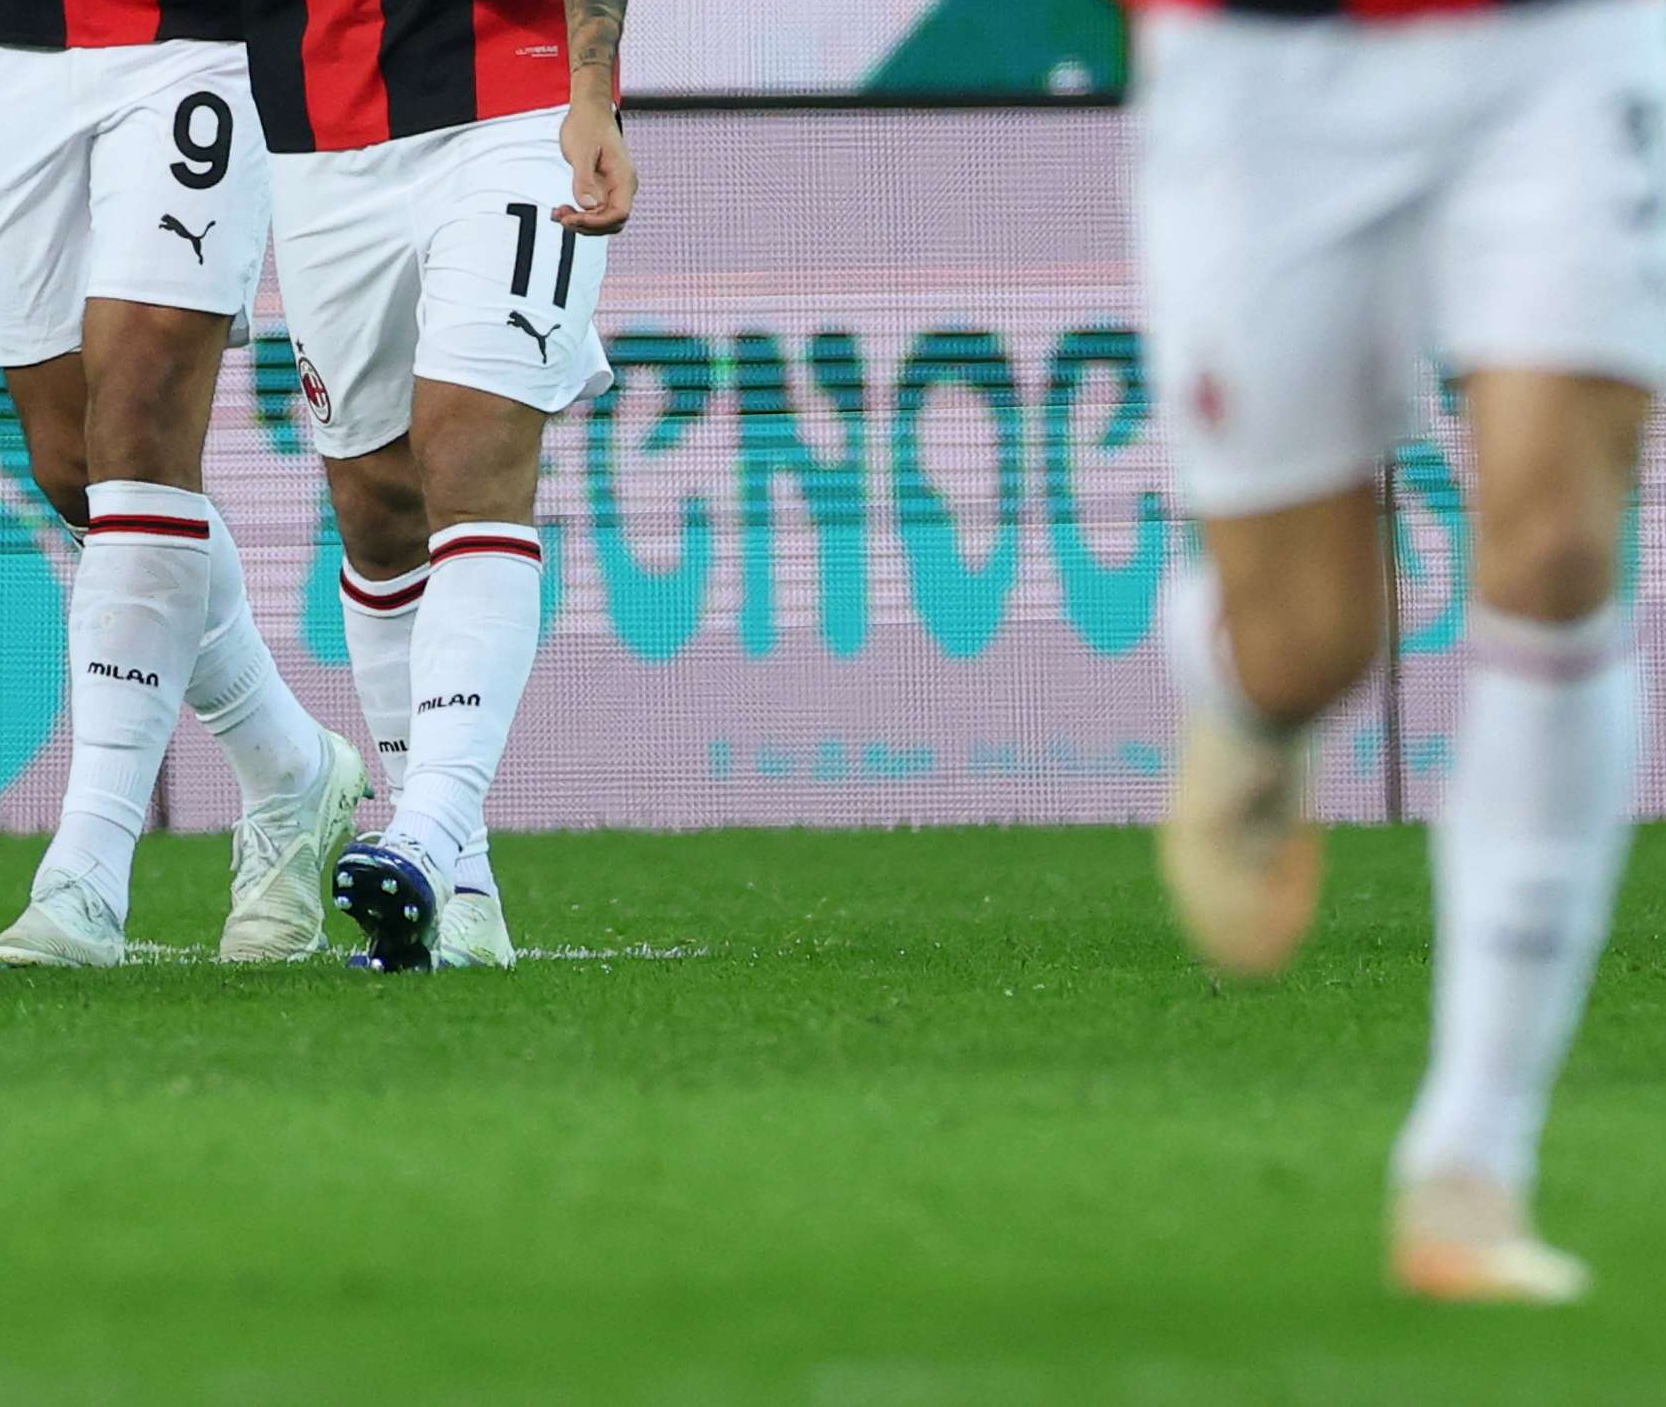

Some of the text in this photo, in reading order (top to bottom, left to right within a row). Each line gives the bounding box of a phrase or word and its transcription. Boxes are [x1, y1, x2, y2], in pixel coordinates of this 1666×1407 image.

[169, 90, 234, 190] 9
[506, 203, 577, 310] 11
[87, 661, 159, 688] MILAN
[417, 693, 481, 714] MILAN
[378, 739, 409, 753] MIL
